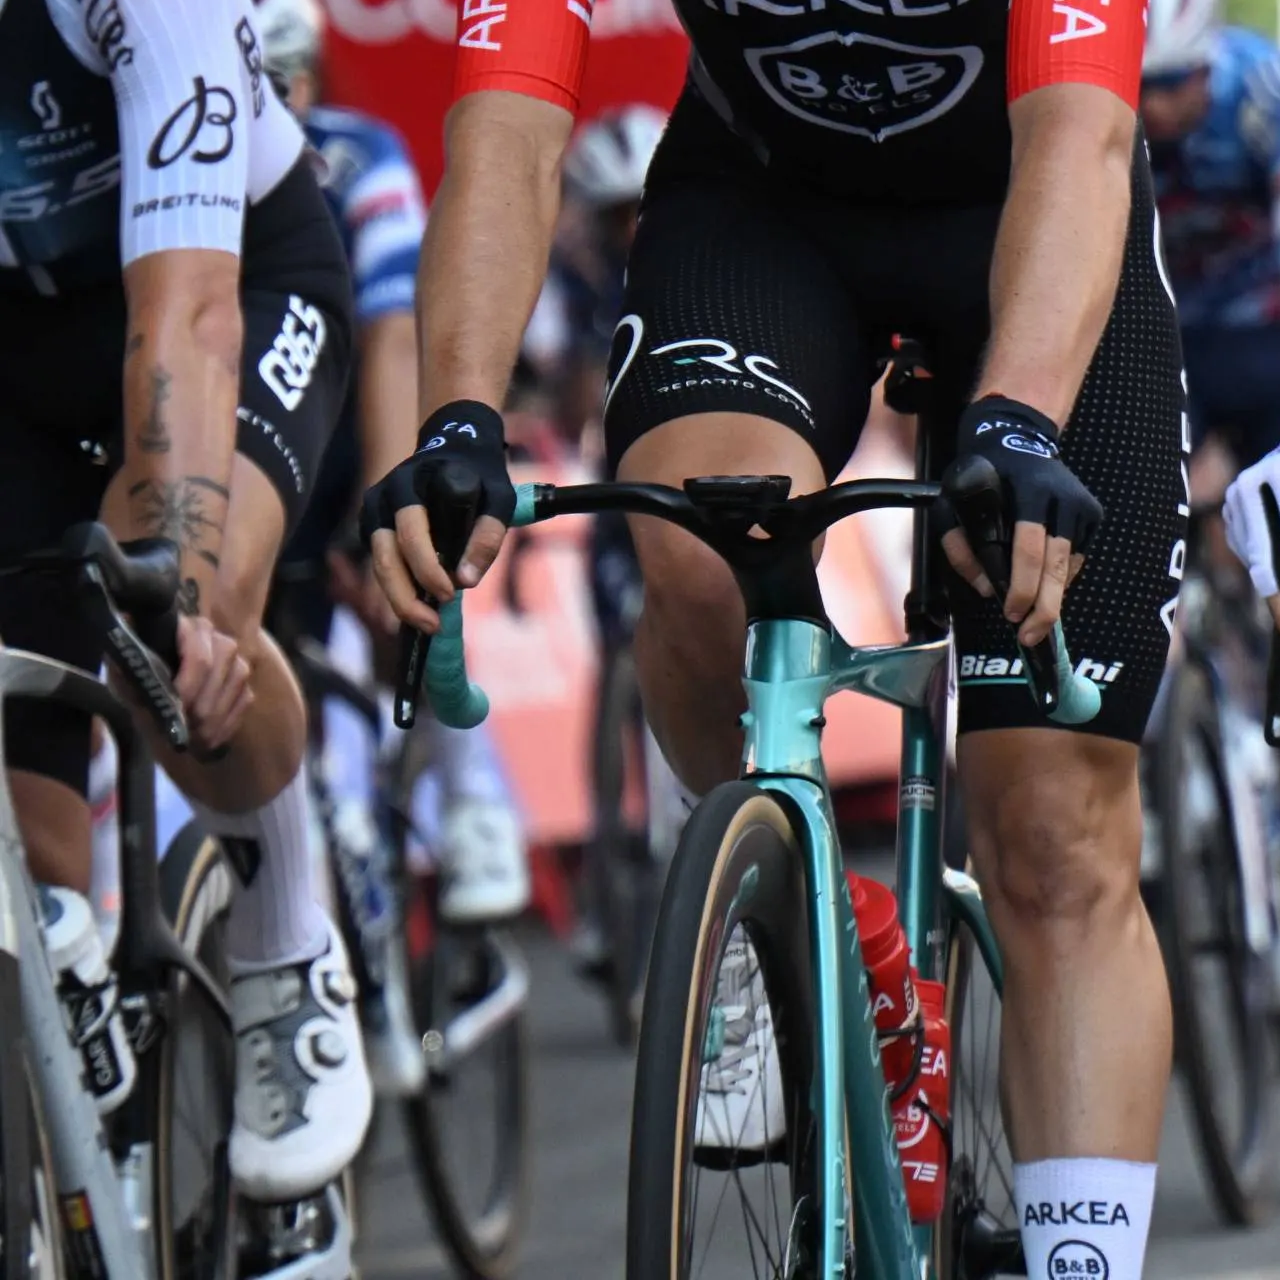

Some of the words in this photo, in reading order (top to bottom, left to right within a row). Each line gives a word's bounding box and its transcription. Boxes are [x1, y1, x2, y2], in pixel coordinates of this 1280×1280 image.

[132, 192, 242, 219] BREITLING
[1024, 1201, 1131, 1227] ARKEA
[1053, 1258, 1102, 1275] B&B
